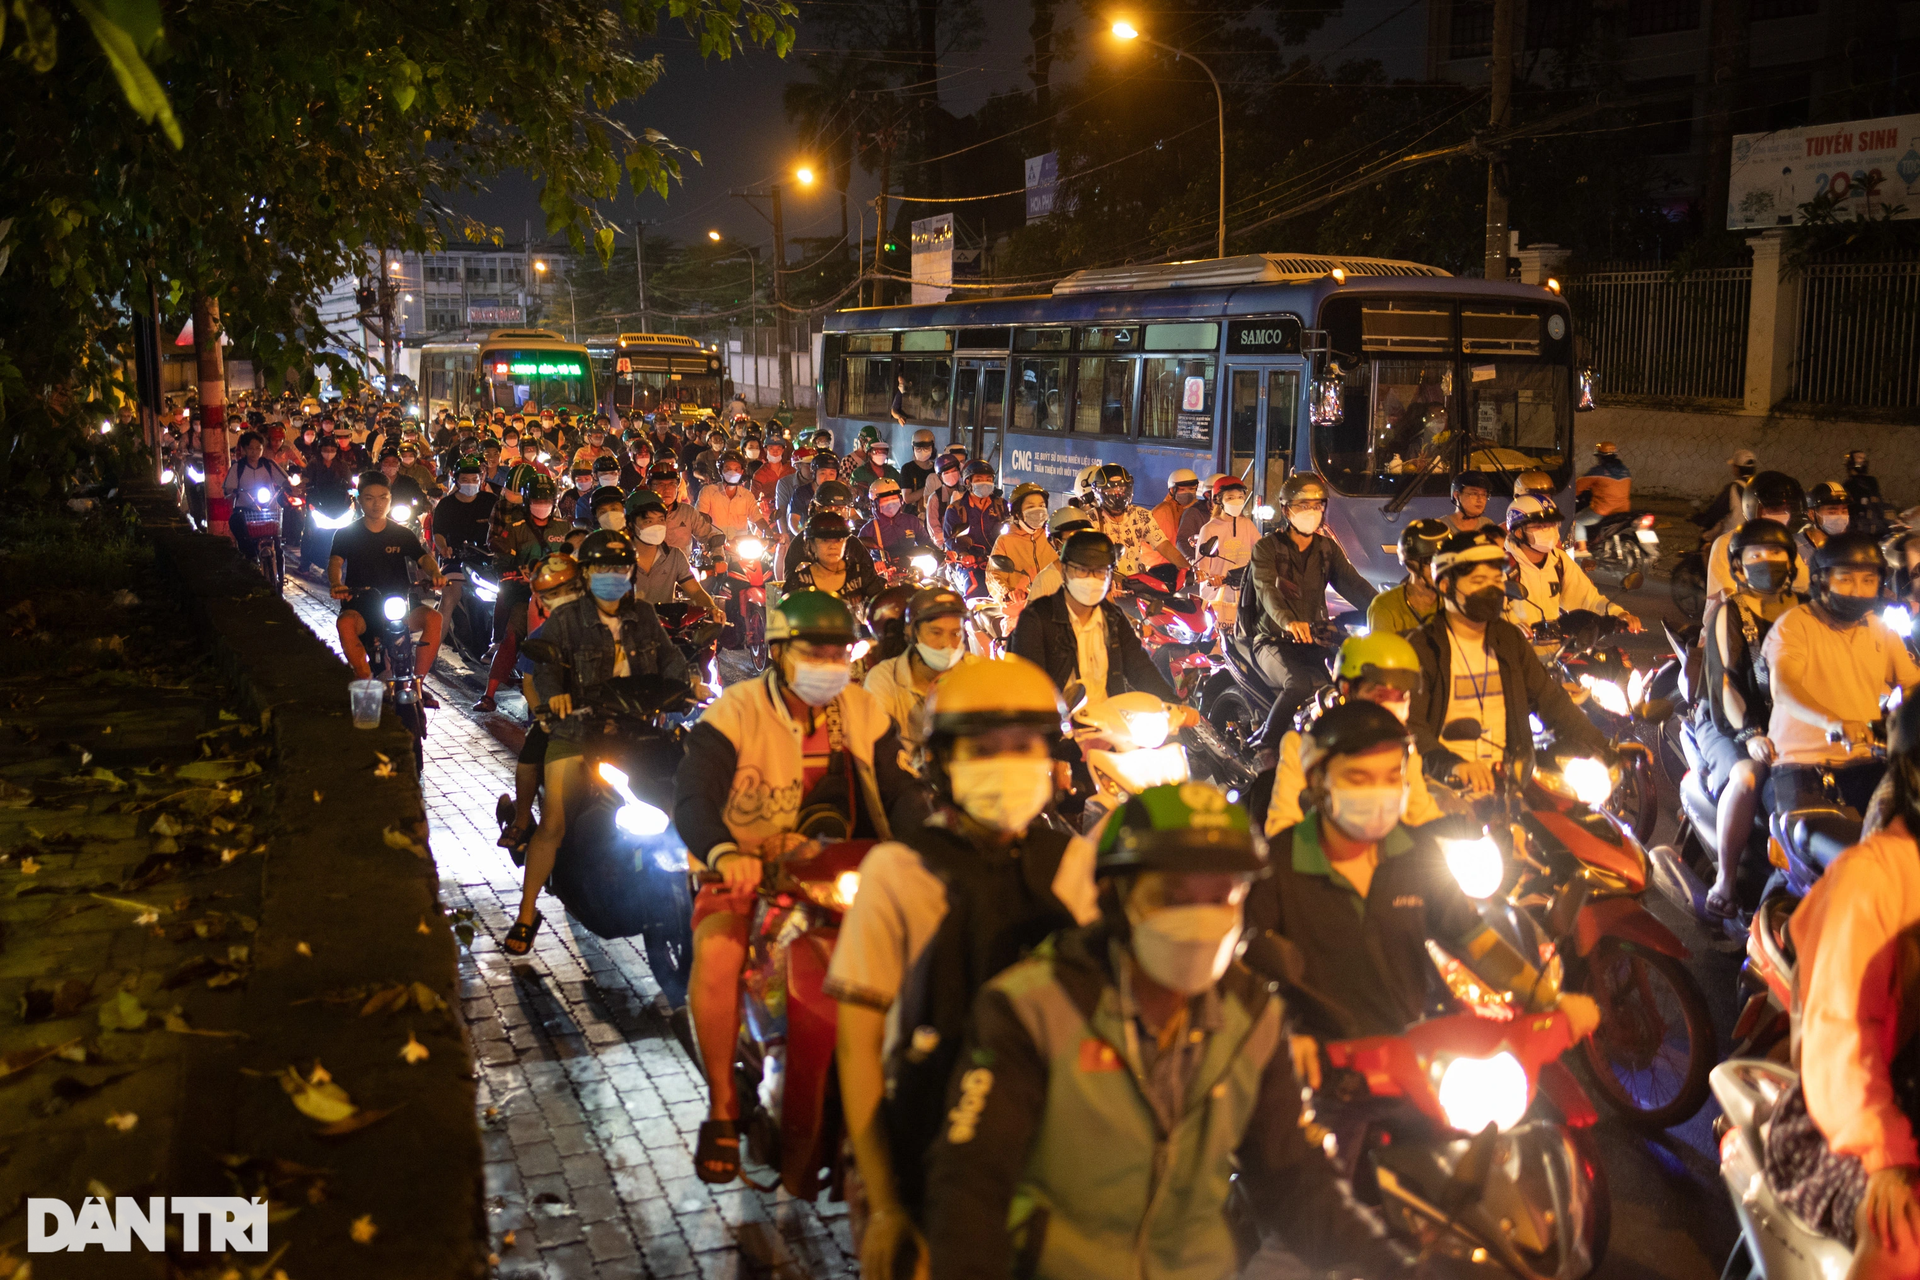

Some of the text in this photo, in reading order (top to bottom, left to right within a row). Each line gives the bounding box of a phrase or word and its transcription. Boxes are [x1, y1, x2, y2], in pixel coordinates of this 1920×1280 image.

[1806, 127, 1854, 157] TUYỂN
[1858, 128, 1898, 152] SINH
[1241, 329, 1282, 345] SAMCO
[1187, 380, 1201, 409] 8
[1011, 449, 1032, 472] CNG
[1034, 452, 1040, 460] XE
[1068, 454, 1080, 465] NHIÊN
[1034, 463, 1044, 473] THÂN
[1045, 465, 1056, 476] THIỆN
